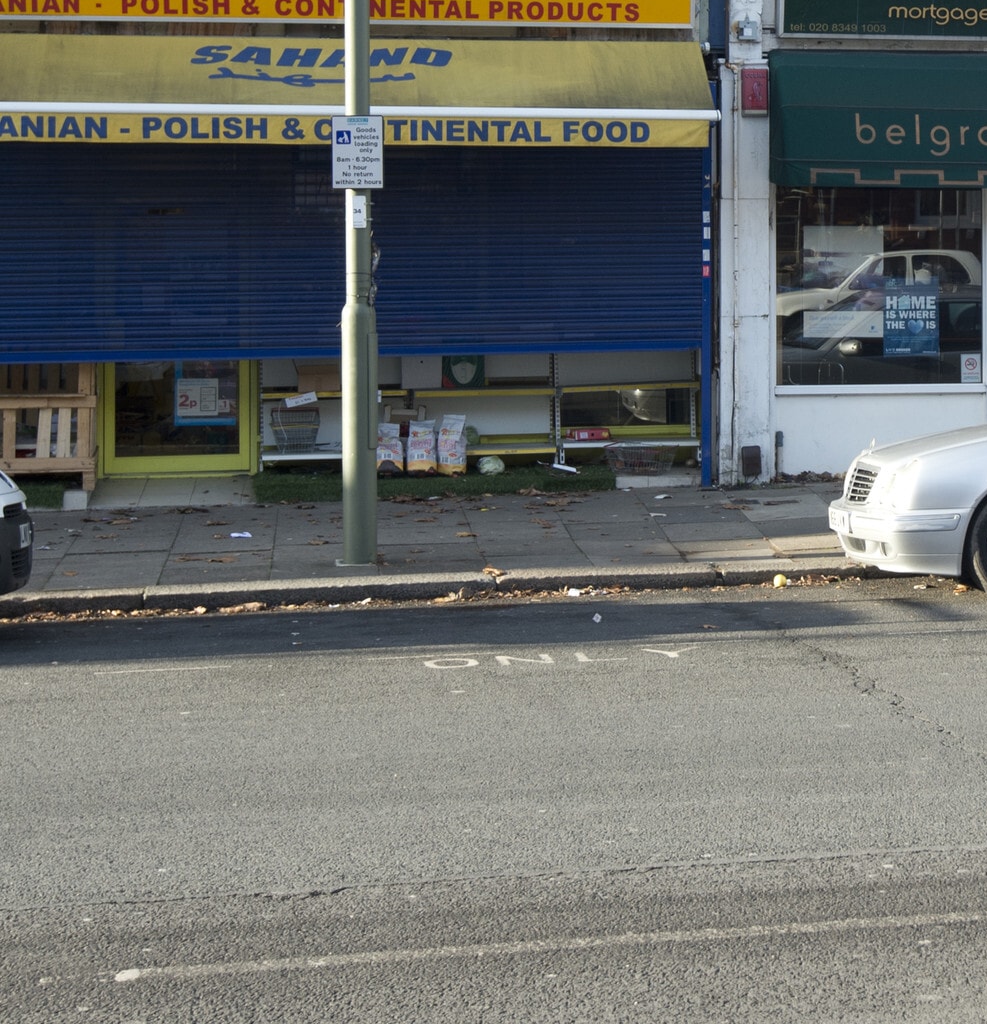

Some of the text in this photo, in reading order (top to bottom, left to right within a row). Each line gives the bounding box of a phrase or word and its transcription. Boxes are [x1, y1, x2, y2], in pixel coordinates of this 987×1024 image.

[488, 1, 640, 22] PRODUCTS
[790, 23, 886, 33] tel: 020 8349 1003
[142, 117, 268, 140] POLISH
[281, 118, 305, 140] &
[314, 119, 552, 142] CTINENTAL
[563, 121, 650, 143] FOOD
[886, 311, 936, 319] IS WHERE
[886, 320, 936, 329] THE IS
[424, 647, 700, 668] ONLY
